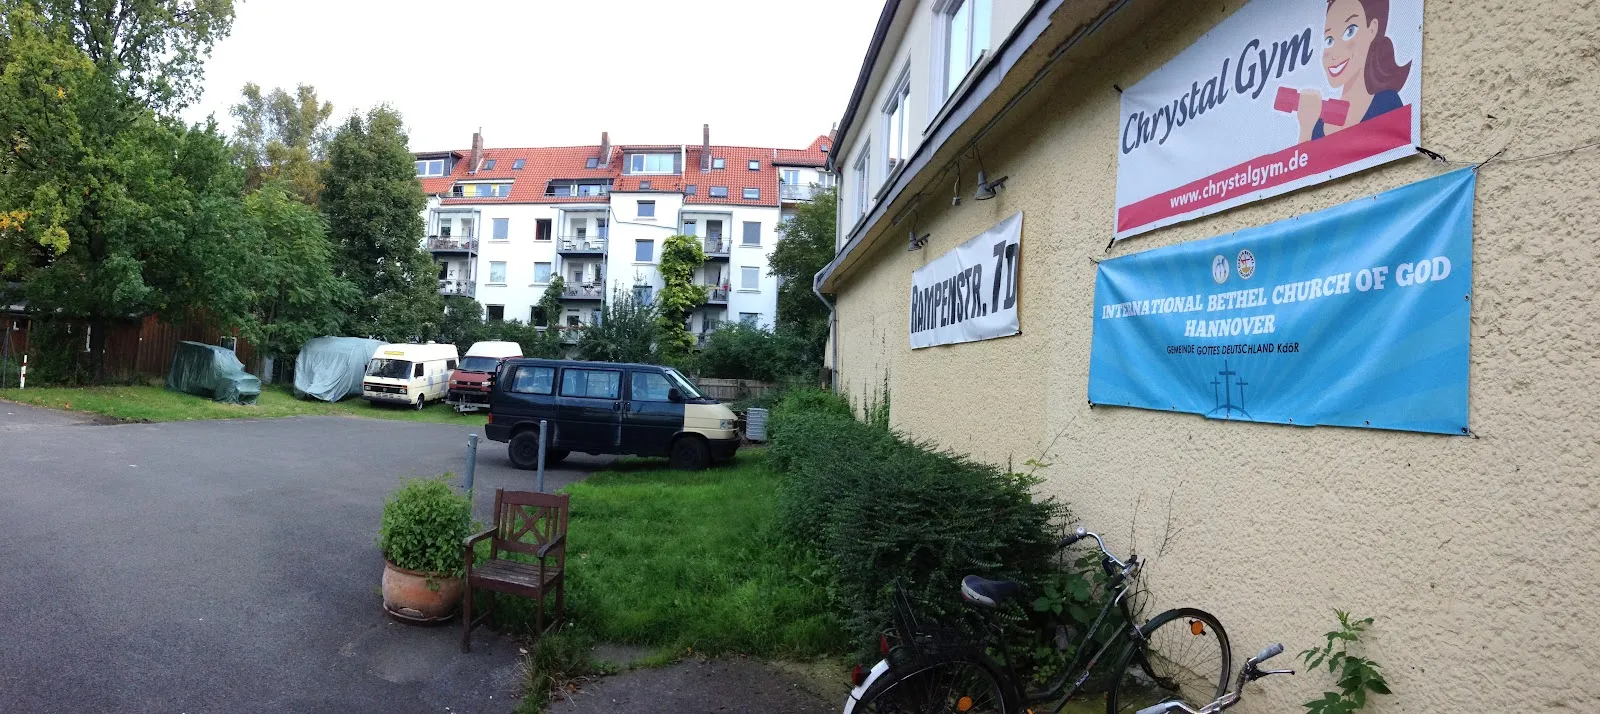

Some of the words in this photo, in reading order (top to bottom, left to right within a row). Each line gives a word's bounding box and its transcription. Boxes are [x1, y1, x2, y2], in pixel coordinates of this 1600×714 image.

[1121, 57, 1230, 154] Chrystal
[1234, 27, 1313, 99] Gym
[1169, 149, 1309, 208] www.chrystalgym.de
[911, 263, 987, 334] RAMPENSTR.
[992, 239, 1019, 313] 7D
[1102, 294, 1203, 319] INTERNATIONAL
[1206, 287, 1267, 312] BETHEL
[1272, 272, 1352, 304] CHURCH
[1355, 266, 1389, 292] OF
[1395, 256, 1452, 287] GOD
[1166, 344, 1195, 355] GEMEINDE
[1196, 345, 1220, 356] GOTTES
[1221, 343, 1274, 355] DEUTSCHLAND
[1277, 342, 1300, 354] KdöR
[1184, 314, 1275, 338] HANNOVER
